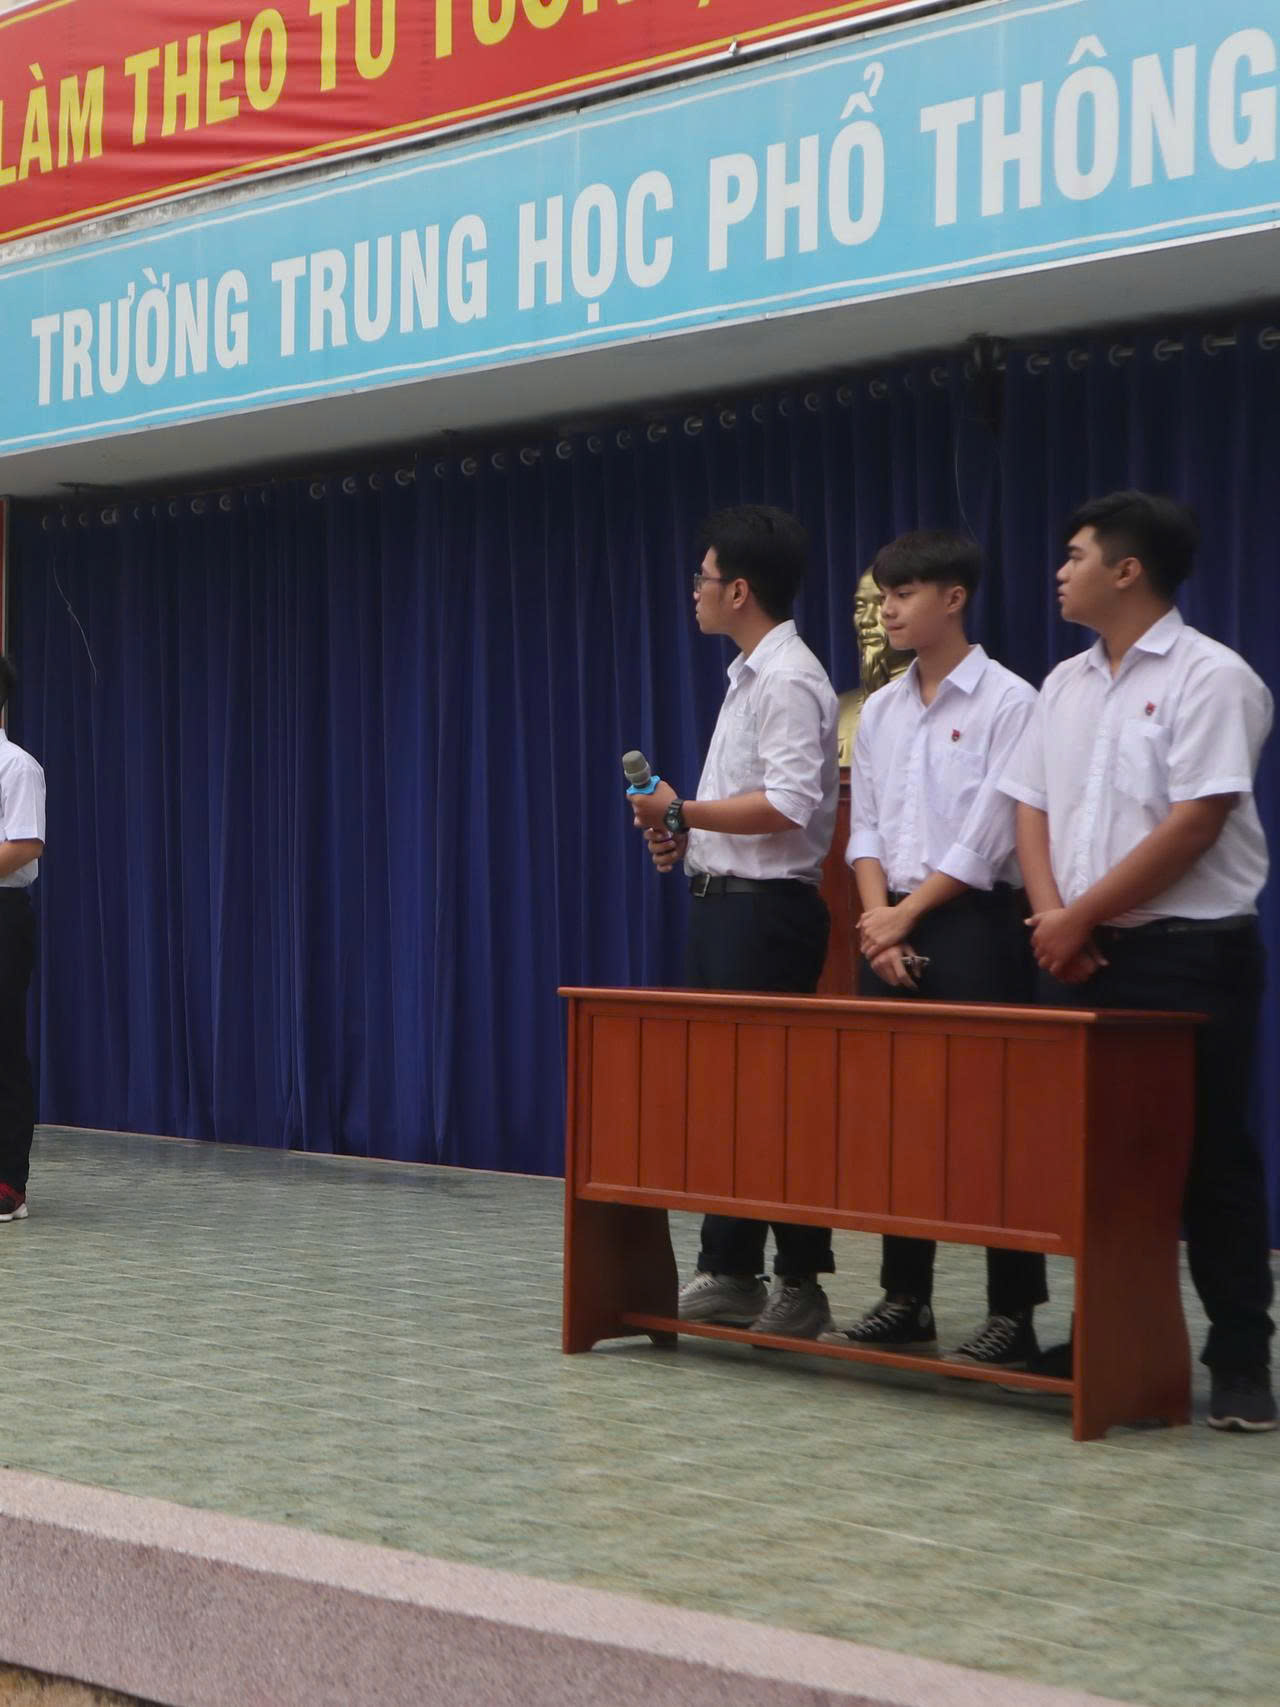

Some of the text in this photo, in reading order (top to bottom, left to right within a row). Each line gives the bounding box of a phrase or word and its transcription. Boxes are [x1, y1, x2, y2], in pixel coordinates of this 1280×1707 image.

[125, 8, 288, 145] THEO
[31, 28, 1277, 405] TRƯỜNG TRUNG HỌC PHỔ THÔNG
